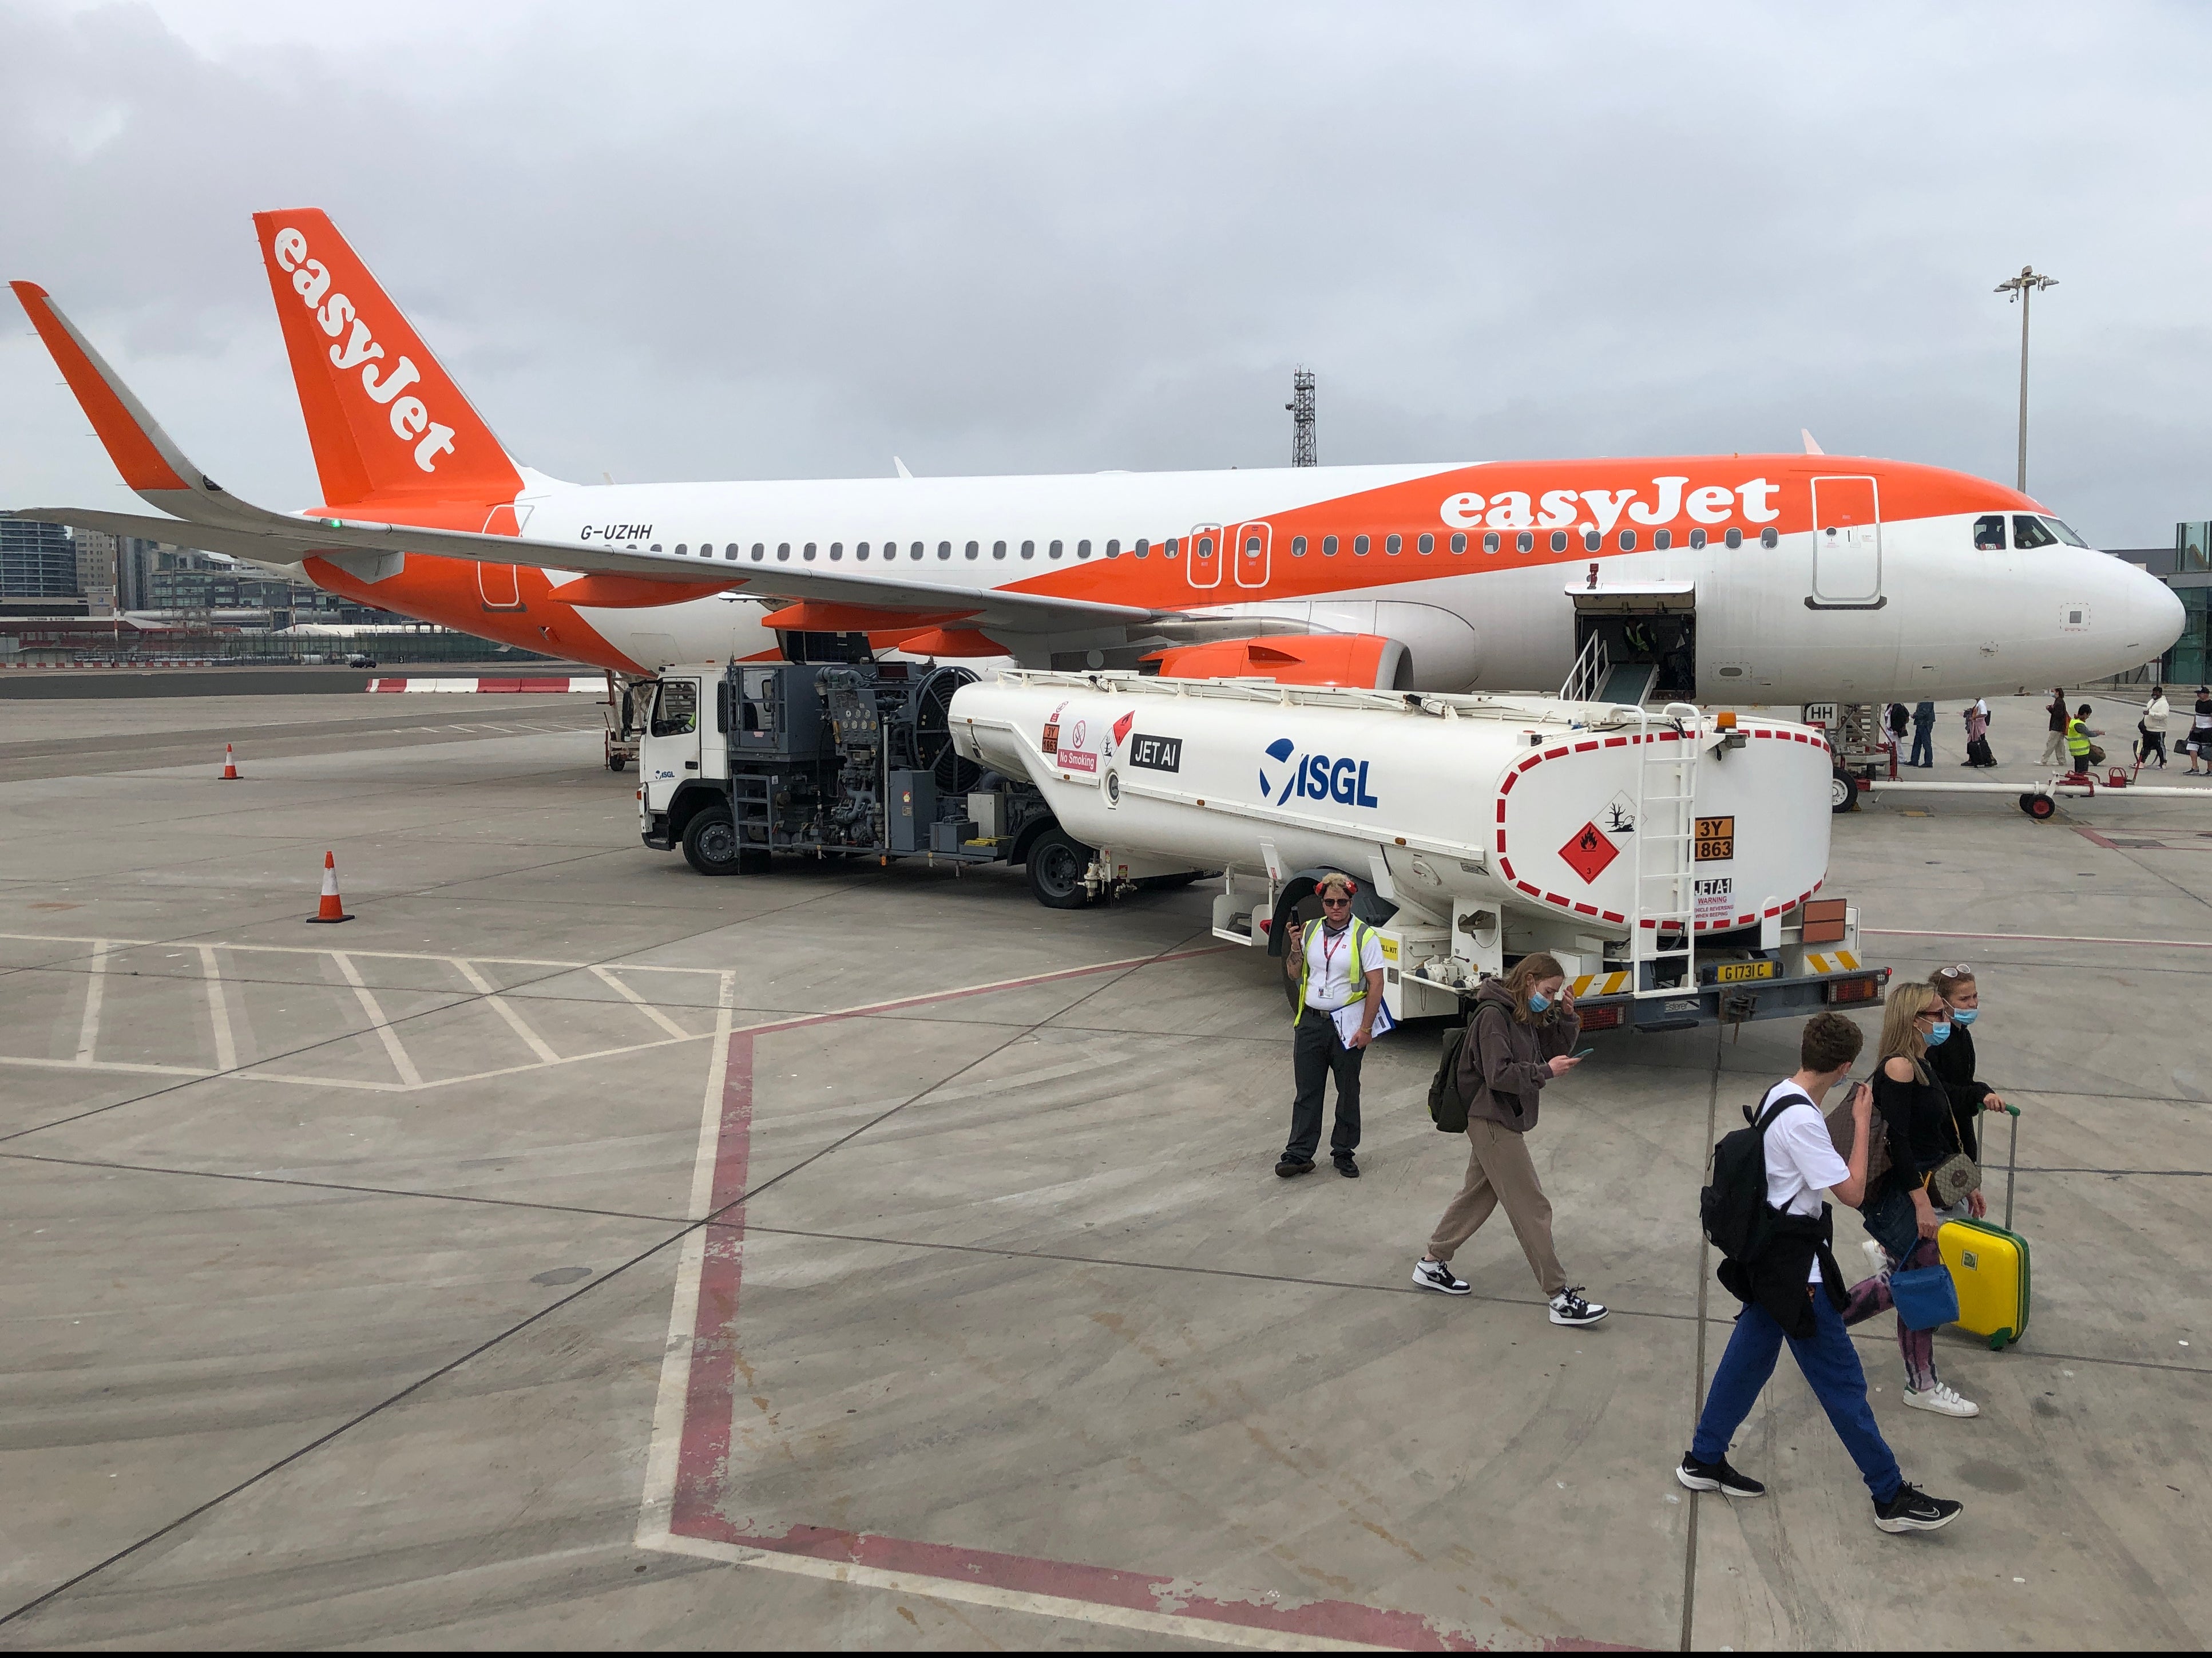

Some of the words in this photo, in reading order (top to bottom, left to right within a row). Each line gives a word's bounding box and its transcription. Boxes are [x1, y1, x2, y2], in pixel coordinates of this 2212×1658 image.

[275, 227, 455, 473] easyJet
[1440, 476, 1780, 538] easyJet
[581, 524, 653, 540] G-UZHH
[1811, 706, 1833, 719] HH
[1047, 727, 1055, 737] 3Y
[1043, 740, 1057, 751] 1863
[1135, 740, 1160, 764] JET
[1060, 751, 1068, 763] No
[1068, 752, 1095, 770] Smoking
[1297, 754, 1378, 809] ISGL
[1700, 820, 1723, 837] 3Y
[1694, 880, 1716, 896] JET
[1715, 878, 1730, 894] A-1
[1698, 896, 1727, 904] WARNING
[1725, 967, 1732, 980] G
[1758, 964, 1764, 976] C
[1664, 1002, 1688, 1011] Esterer
